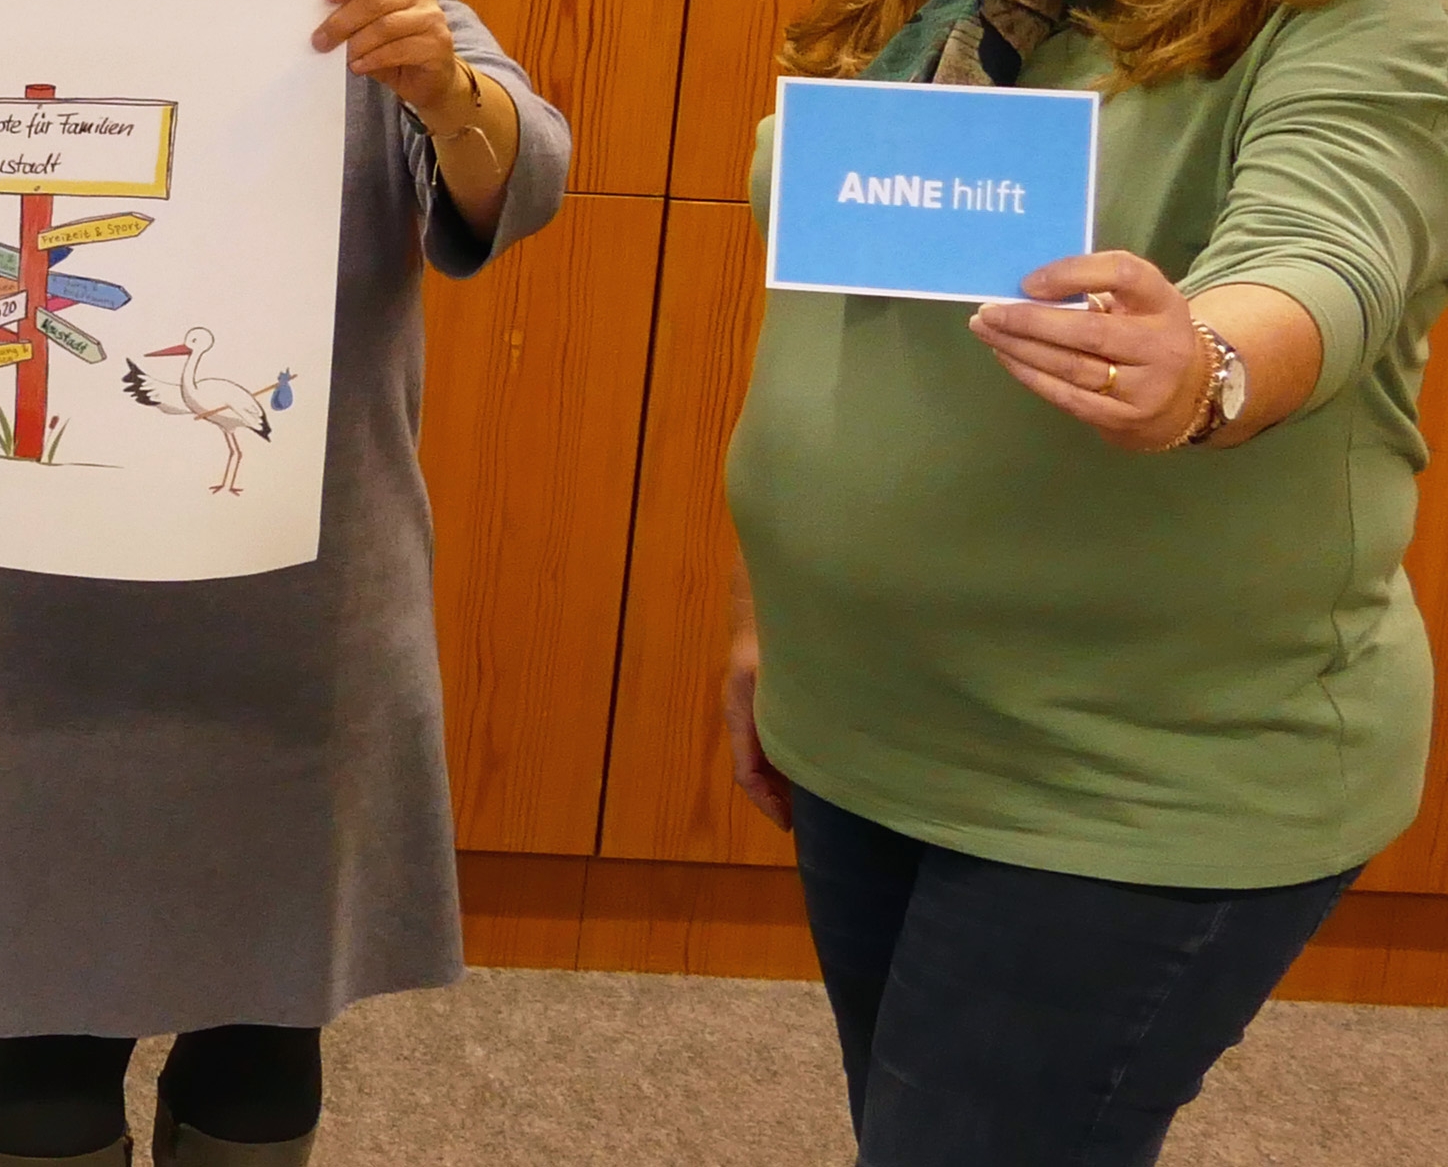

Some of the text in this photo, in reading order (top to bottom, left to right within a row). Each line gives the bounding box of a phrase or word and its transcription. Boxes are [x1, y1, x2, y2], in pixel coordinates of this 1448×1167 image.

[26, 113, 54, 138] für
[57, 112, 135, 136] Familien
[953, 177, 1026, 214] hilft
[107, 221, 142, 235] Sport
